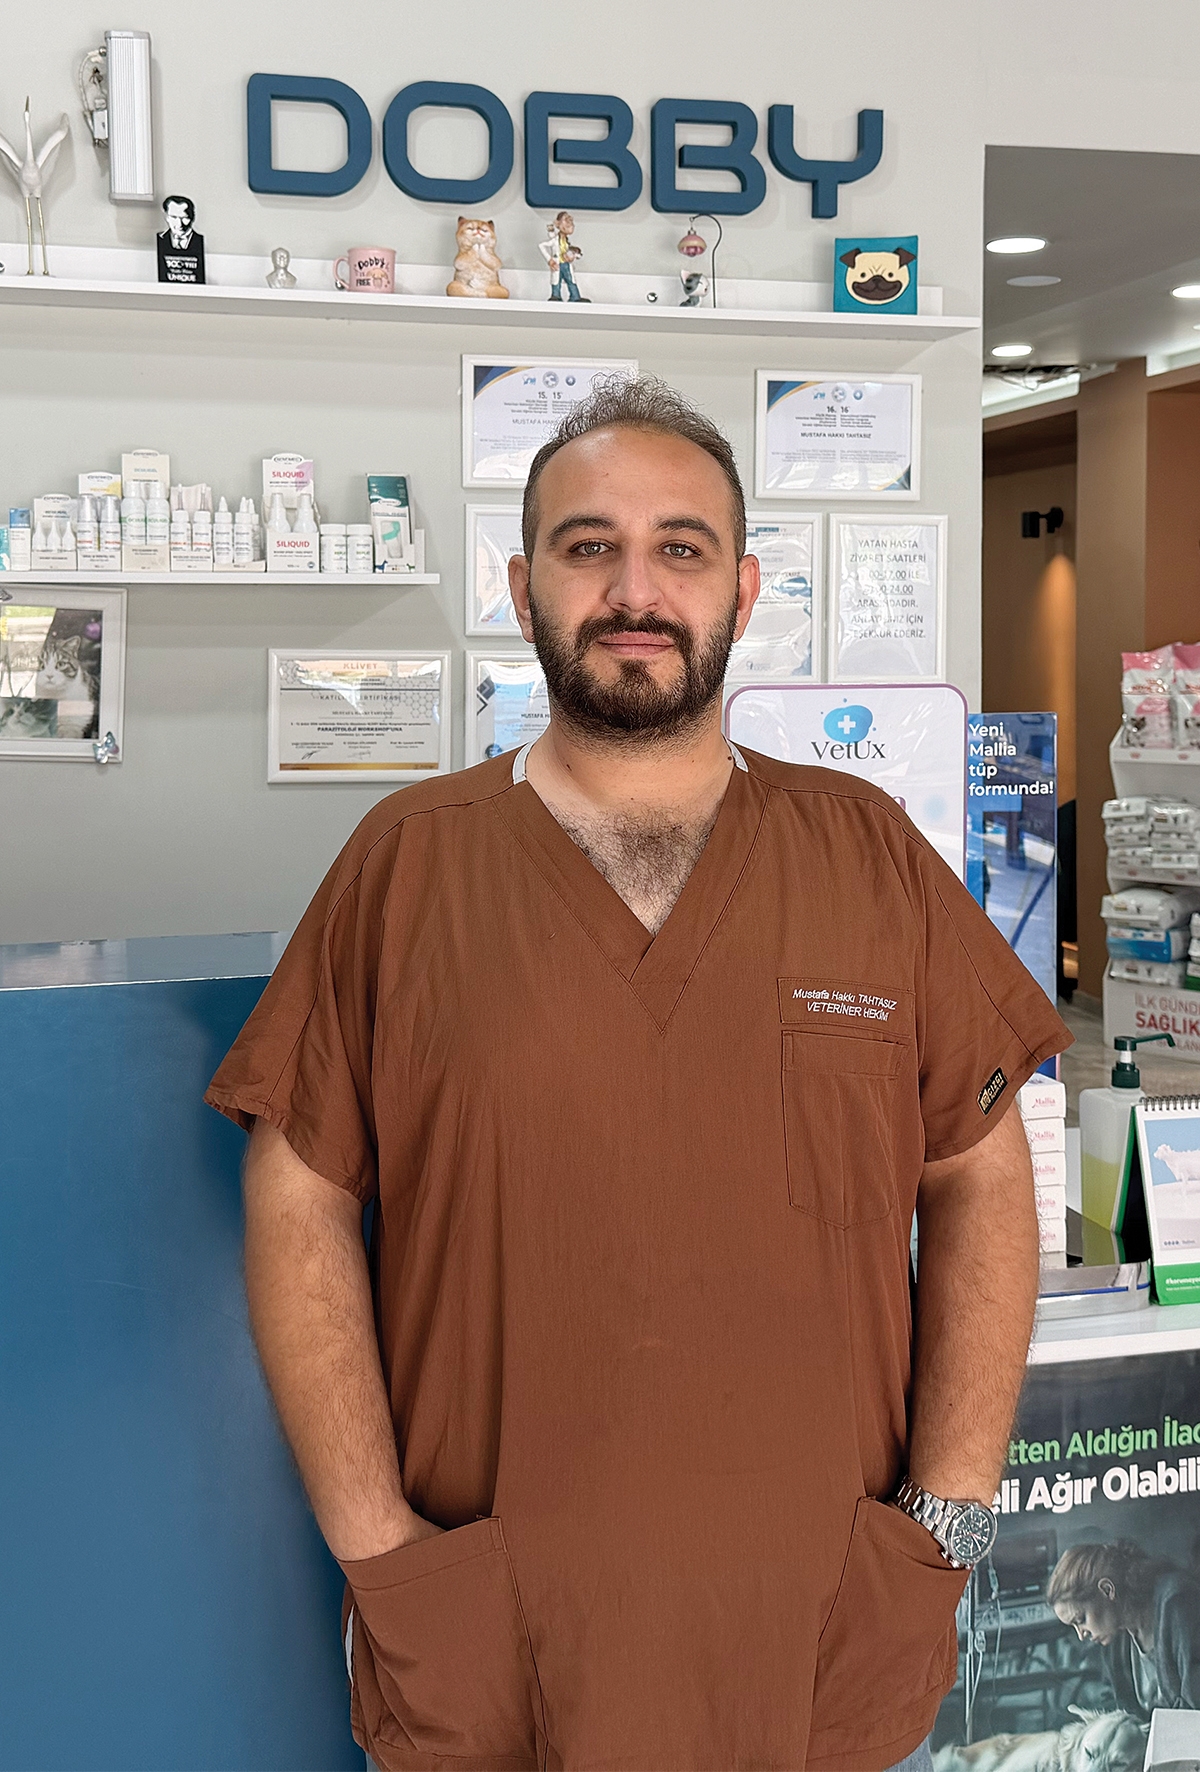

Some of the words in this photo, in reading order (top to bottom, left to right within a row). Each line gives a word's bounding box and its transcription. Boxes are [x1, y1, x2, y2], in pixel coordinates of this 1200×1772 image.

[247, 73, 884, 218] DOBBY
[167, 272, 197, 282] UNIQUE
[356, 279, 371, 287] FREE
[538, 391, 548, 400] 15.
[826, 406, 837, 414] 16.
[272, 471, 304, 479] SILIQUID
[276, 540, 310, 549] SILIQUID
[858, 539, 887, 549] YATAN
[890, 540, 918, 549] HASTA
[850, 553, 883, 563] ZİYARET
[887, 553, 926, 563] SAATLERİ
[906, 614, 923, 625] İÇİN
[969, 722, 1004, 737] Yeni
[811, 740, 886, 760] VetUx
[969, 743, 1017, 757] Mallia
[969, 764, 998, 779] tüp
[968, 781, 1054, 797] formunda!
[792, 988, 830, 999] Mustafa
[831, 990, 856, 1003] Hakkı
[858, 993, 898, 1010] TAHTASIZ
[1159, 995, 1200, 1016] GÜND
[806, 1001, 862, 1017] VETERİNER
[863, 1006, 890, 1022] HEKİM
[1033, 1097, 1056, 1107] Mallia
[1032, 1130, 1055, 1140] Mallia
[1034, 1165, 1056, 1174] Mallia
[1066, 1424, 1158, 1458] Aldığın
[1025, 1471, 1098, 1514] Ağır
